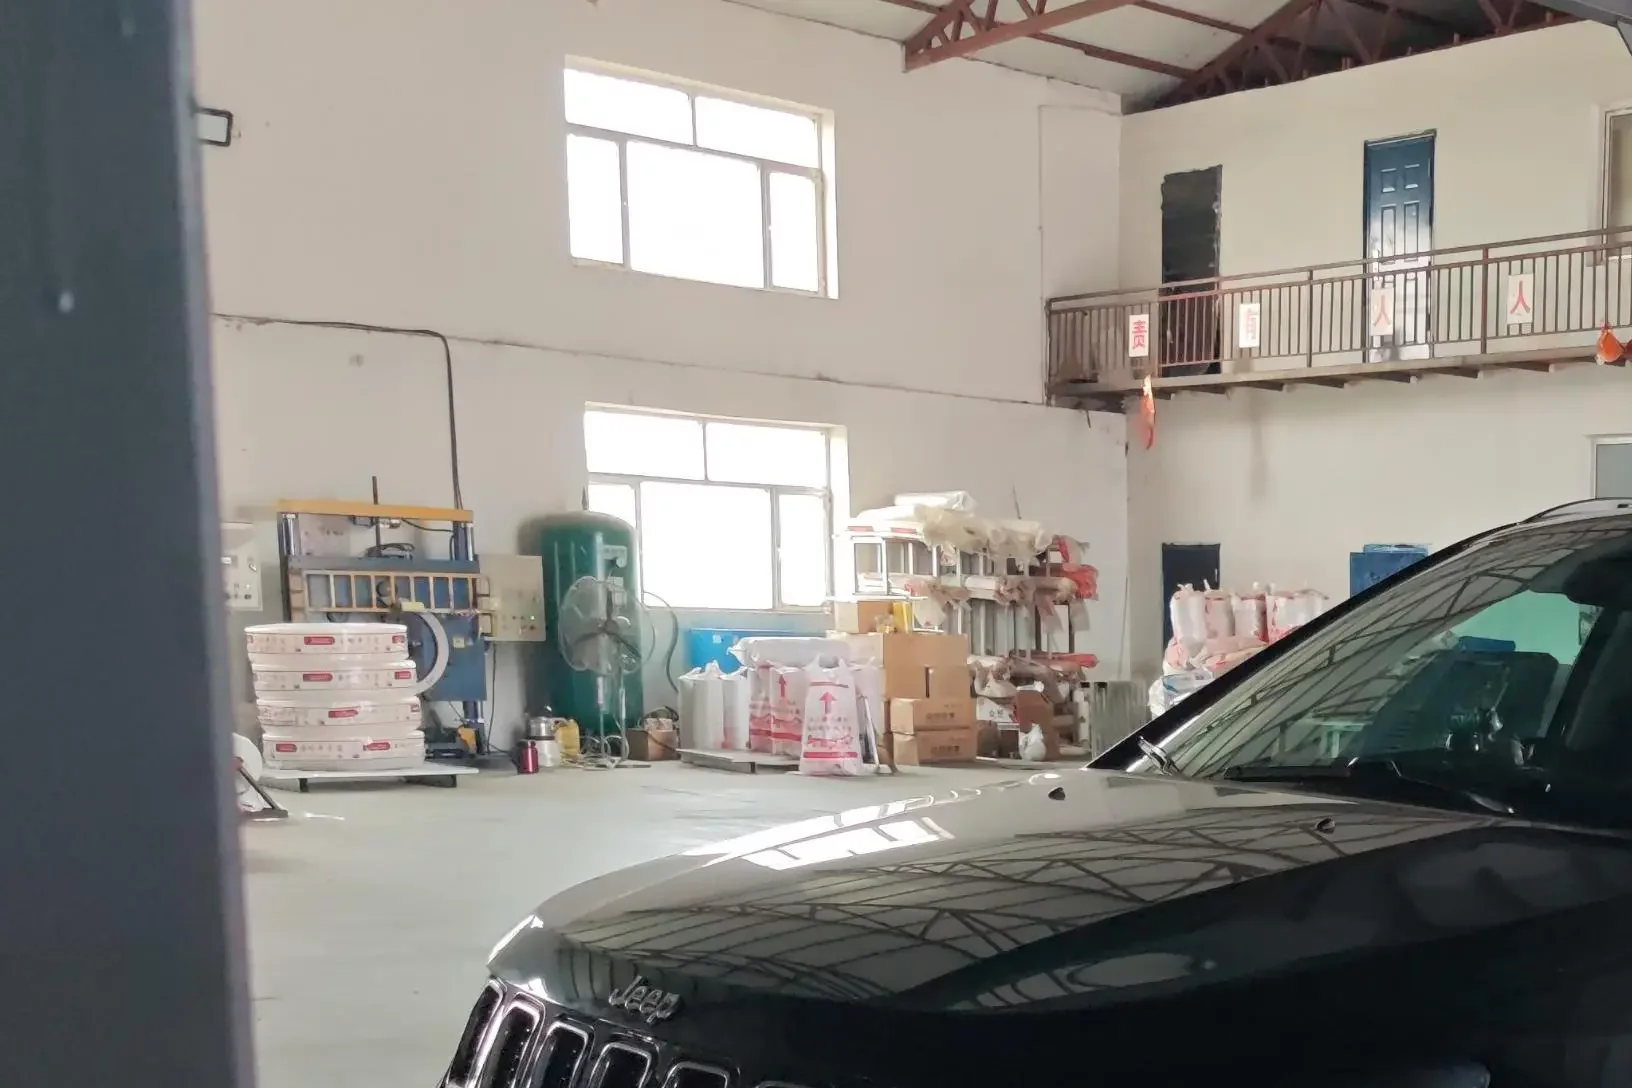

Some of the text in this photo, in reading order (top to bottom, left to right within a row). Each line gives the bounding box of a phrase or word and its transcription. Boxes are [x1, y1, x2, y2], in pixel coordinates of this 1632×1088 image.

[1373, 295, 1391, 327] 人
[1510, 280, 1531, 314] 人
[1131, 320, 1148, 350] 责
[608, 975, 681, 1025] Jeep
